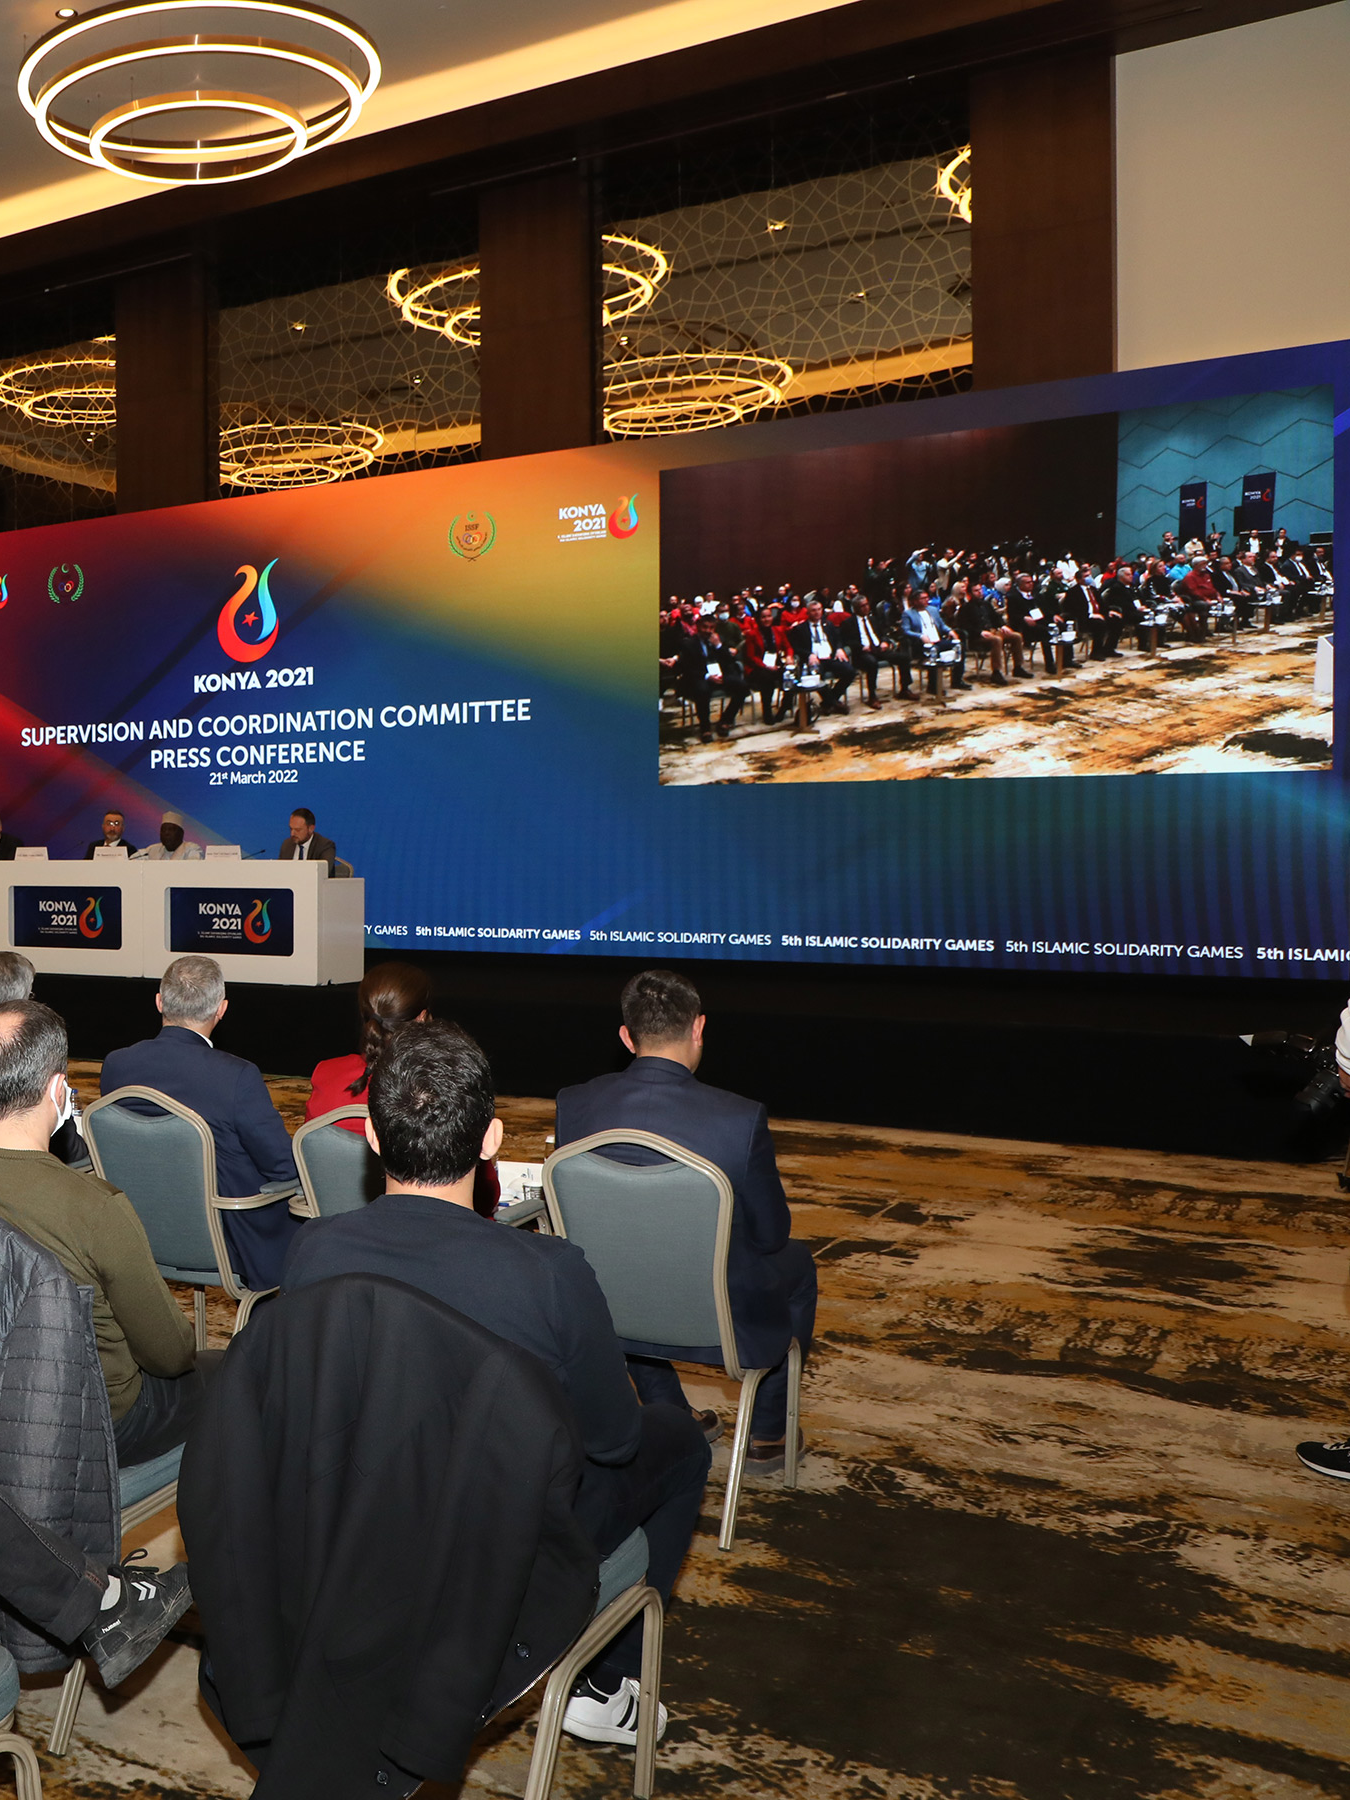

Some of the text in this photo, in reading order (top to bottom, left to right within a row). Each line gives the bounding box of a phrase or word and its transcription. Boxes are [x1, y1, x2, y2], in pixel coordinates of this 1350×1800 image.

[558, 503, 607, 520] KONYA
[573, 516, 606, 532] 2021
[193, 666, 314, 693] KONYA 2021
[21, 698, 531, 747] SUPERVISION AND COORDINATION COMMITTEE
[151, 740, 366, 769] PRESS CONFERENCE
[209, 769, 298, 785] 21st March 2022
[38, 900, 77, 912] KONYA
[198, 903, 242, 915] KONYA
[51, 914, 77, 925] 2021
[211, 917, 242, 930] 2021
[374, 925, 408, 936] GAMES
[415, 926, 432, 937] 5th
[433, 926, 476, 938] ISLAMIC
[477, 928, 541, 939] SOLIDARITY
[542, 928, 581, 940] GAMES
[589, 930, 607, 941] 5th
[610, 931, 655, 943] ISLAMIC
[657, 932, 726, 945] SOLIDARITY
[729, 933, 772, 946] GAMES
[781, 935, 802, 946] 5th
[805, 936, 858, 948] ISLAMIC
[861, 937, 943, 950] SOLIDARITY
[945, 938, 994, 952] GAMES
[1005, 940, 1028, 953] 5th
[1032, 941, 1090, 955] ISLAMIC
[1093, 943, 1184, 957] SOLIDARITY
[1187, 945, 1244, 959] GAMES
[1256, 946, 1284, 960] 5th
